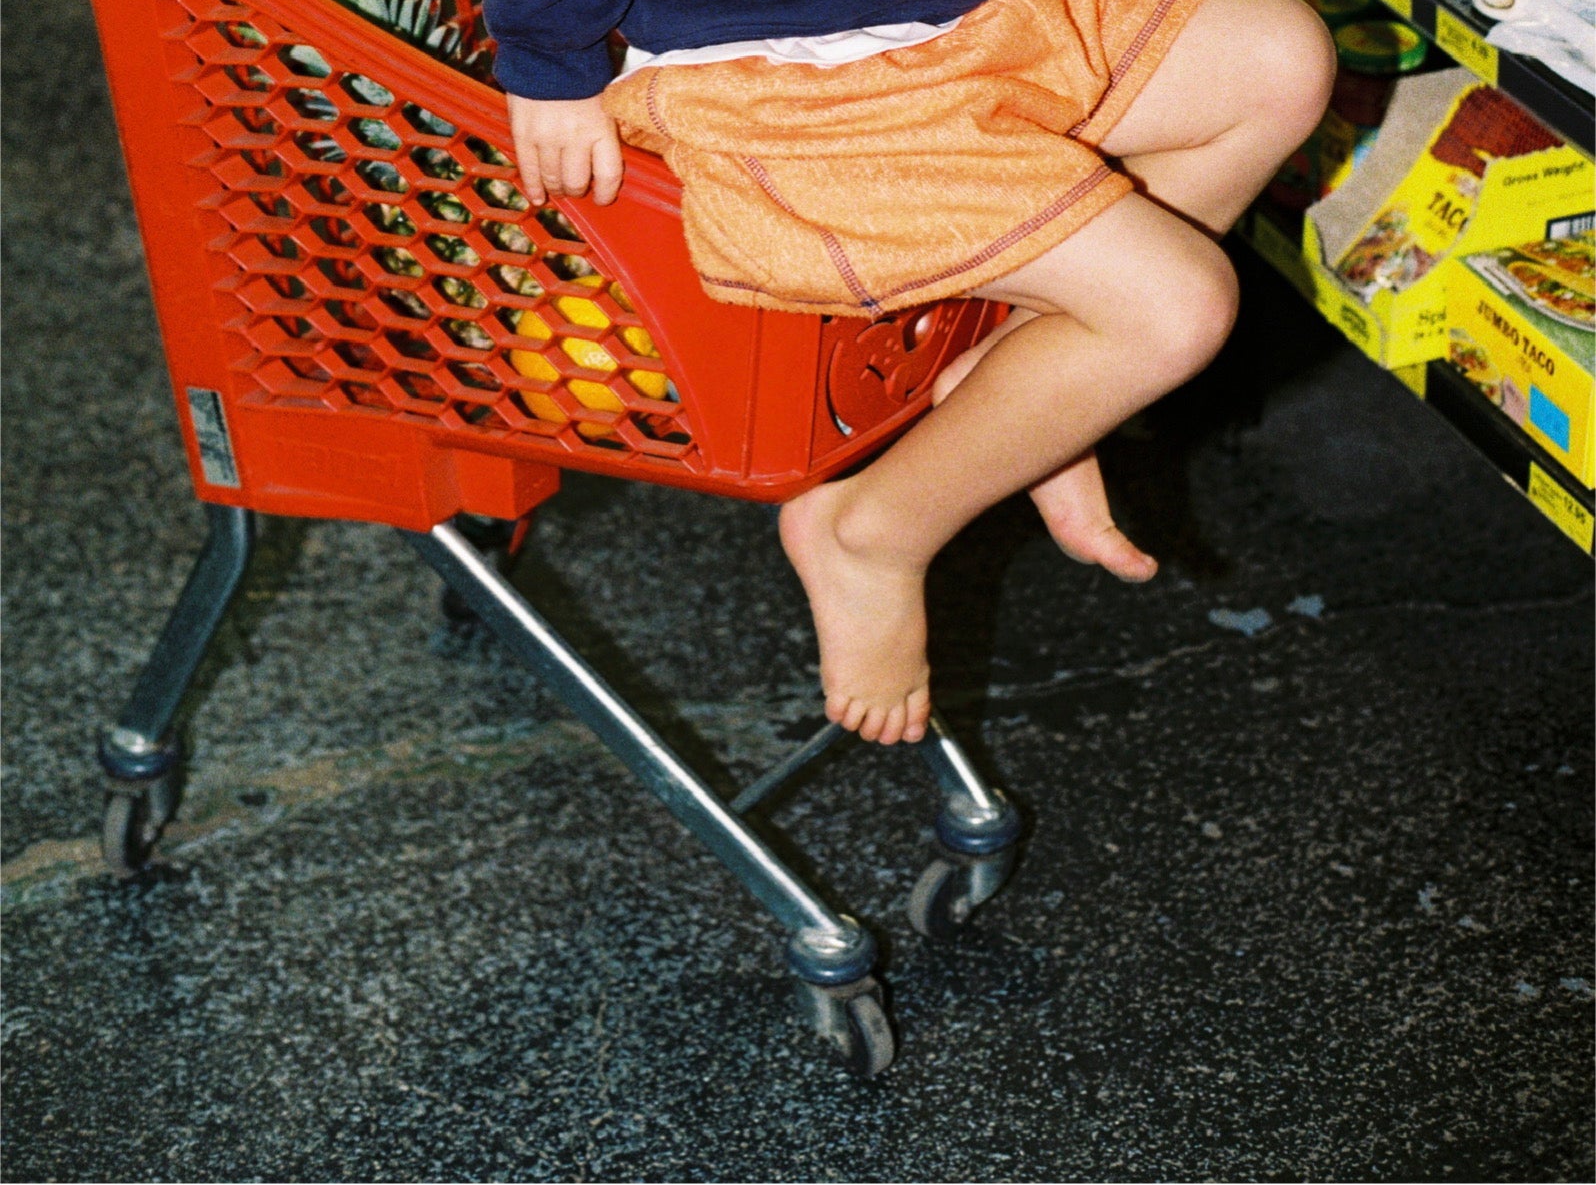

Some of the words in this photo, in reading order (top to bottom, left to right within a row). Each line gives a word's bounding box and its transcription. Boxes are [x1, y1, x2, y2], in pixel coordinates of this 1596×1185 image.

[1503, 172, 1539, 187] Gross
[1542, 161, 1585, 177] Weight
[1477, 299, 1519, 347] JUMBO
[1521, 336, 1556, 377] TACO
